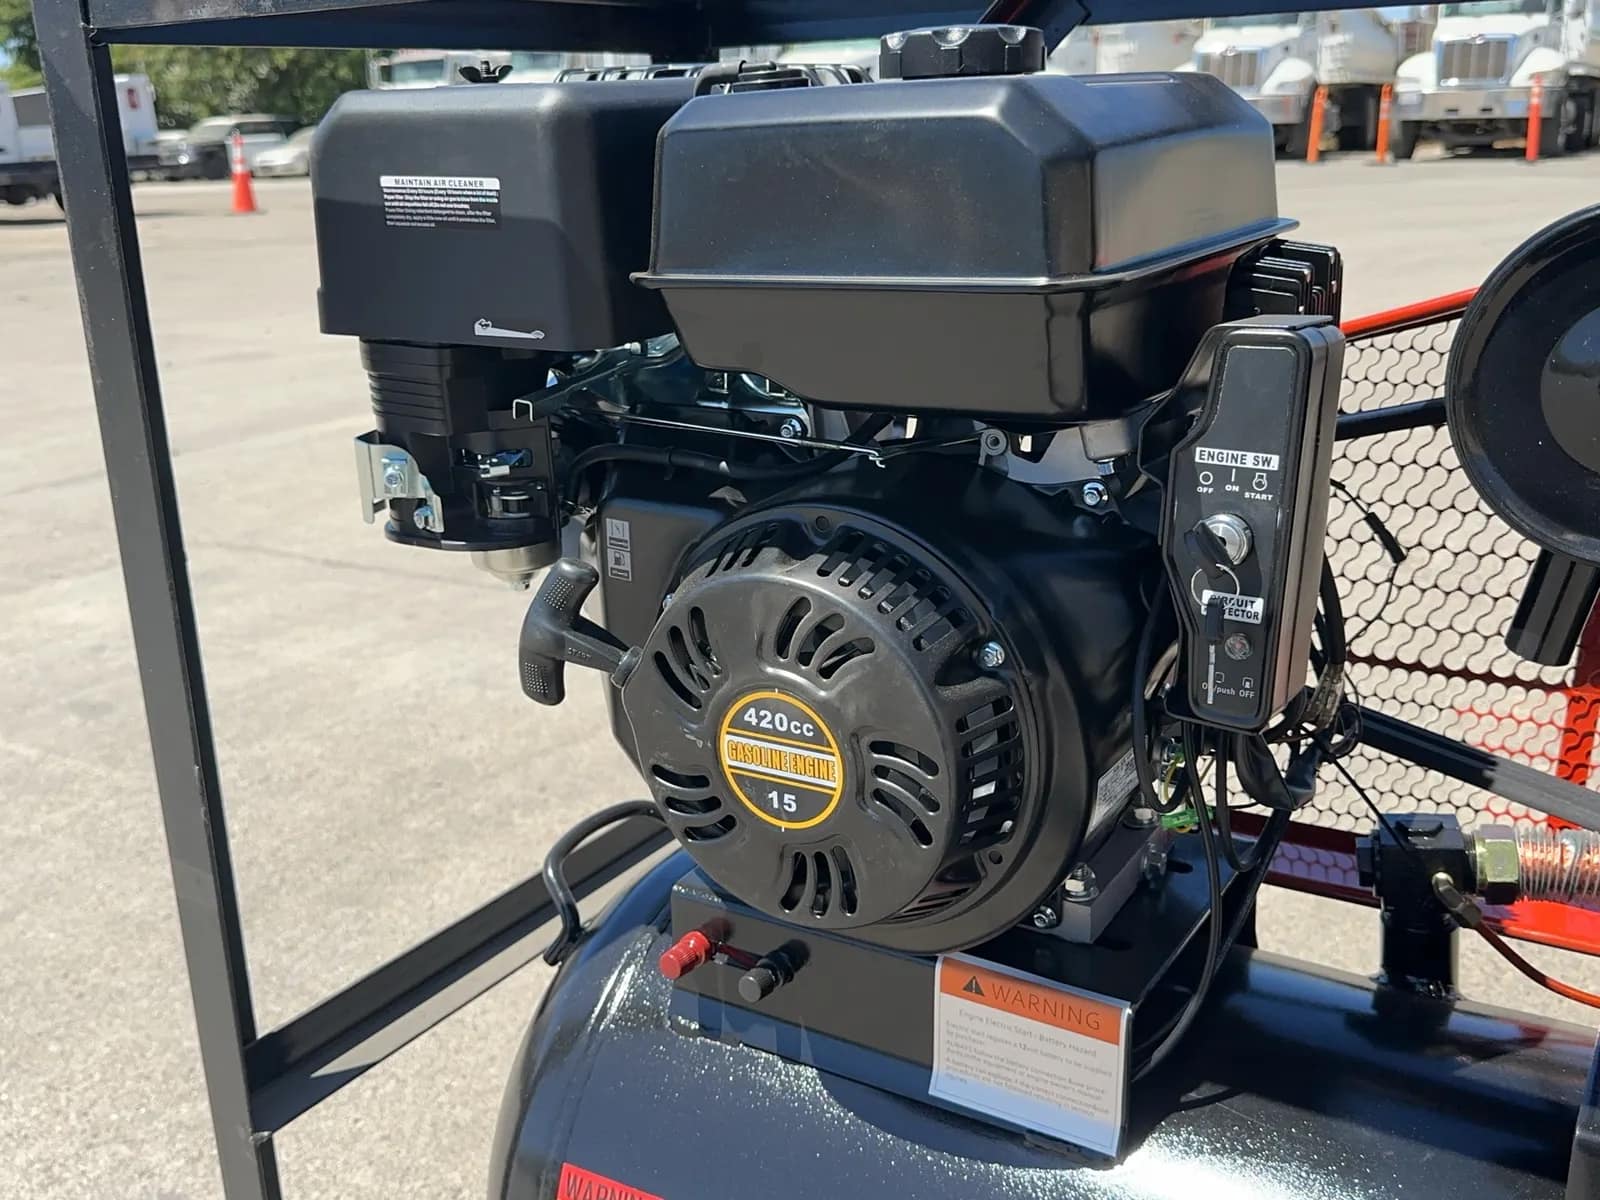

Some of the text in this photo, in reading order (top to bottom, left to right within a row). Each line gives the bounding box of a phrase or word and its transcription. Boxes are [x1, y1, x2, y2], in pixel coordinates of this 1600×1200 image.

[394, 178, 485, 188] MAINTAIN AIR CLEANER
[1199, 450, 1275, 469] ENGINE SW.
[1196, 484, 1273, 501] OFF ON START
[1201, 681, 1255, 699] O/push OFF
[743, 707, 814, 737] 420cc
[727, 740, 836, 782] GASOLINE ENGINE
[768, 790, 797, 813] 15
[991, 983, 1101, 1031] WARNING
